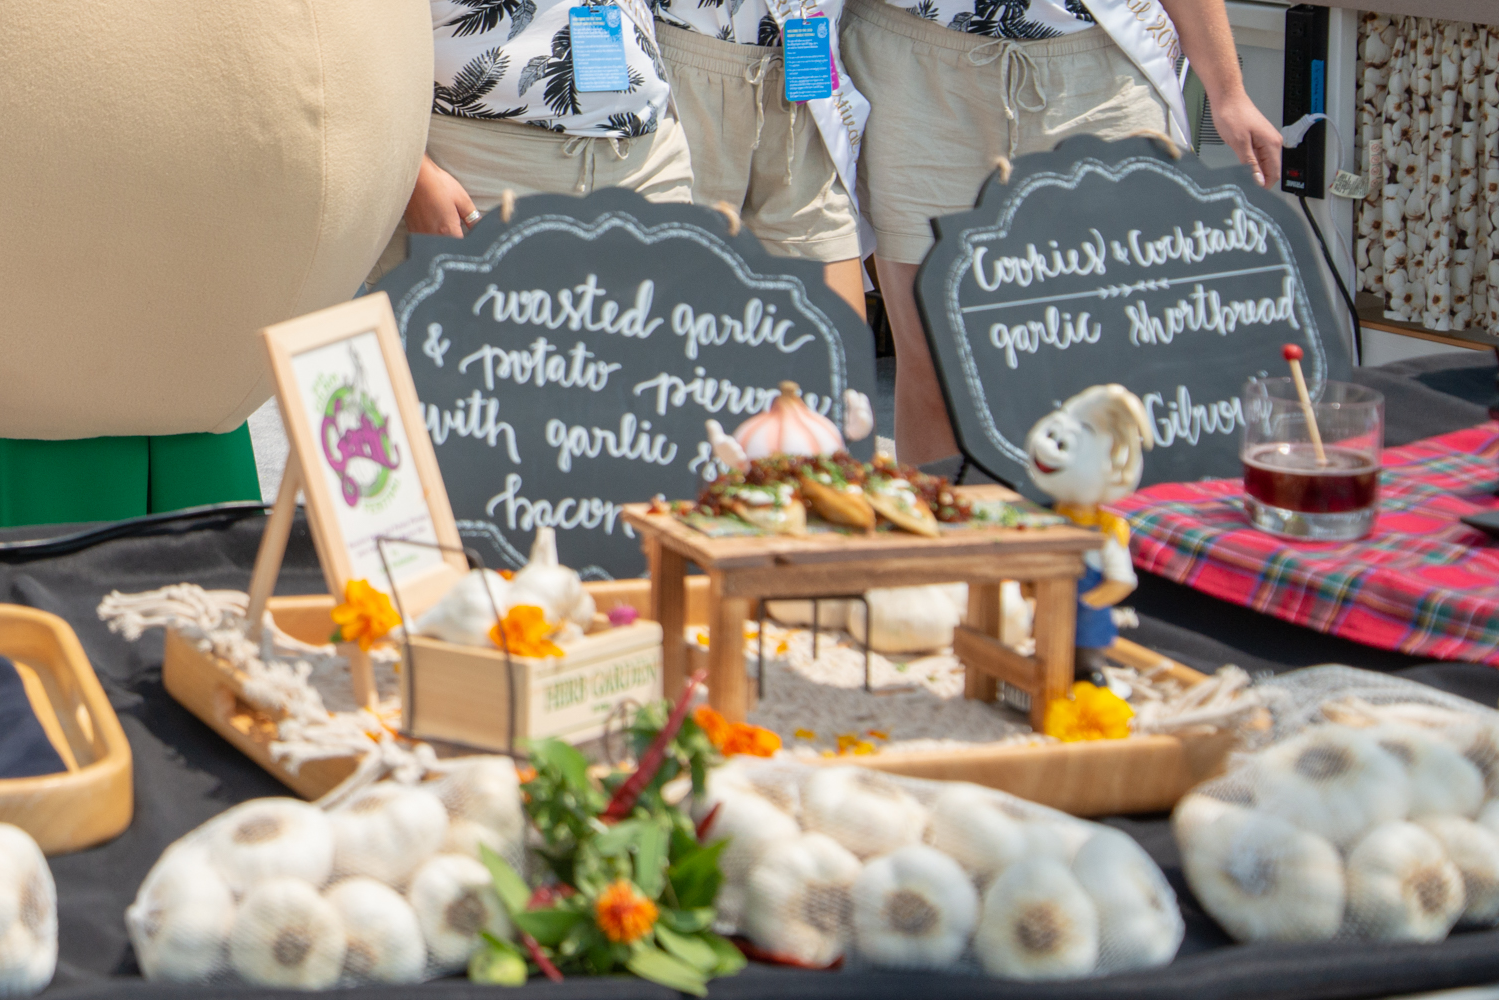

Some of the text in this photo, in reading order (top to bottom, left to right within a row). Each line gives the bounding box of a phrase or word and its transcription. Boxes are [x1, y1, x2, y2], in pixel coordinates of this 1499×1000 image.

[973, 208, 1268, 292] Cookies & Cocktails
[422, 323, 451, 368] &
[459, 337, 622, 391] potato
[473, 273, 816, 360] roasted garlic
[989, 306, 1102, 370] garlic
[419, 388, 522, 464] with
[546, 412, 678, 473] garlic
